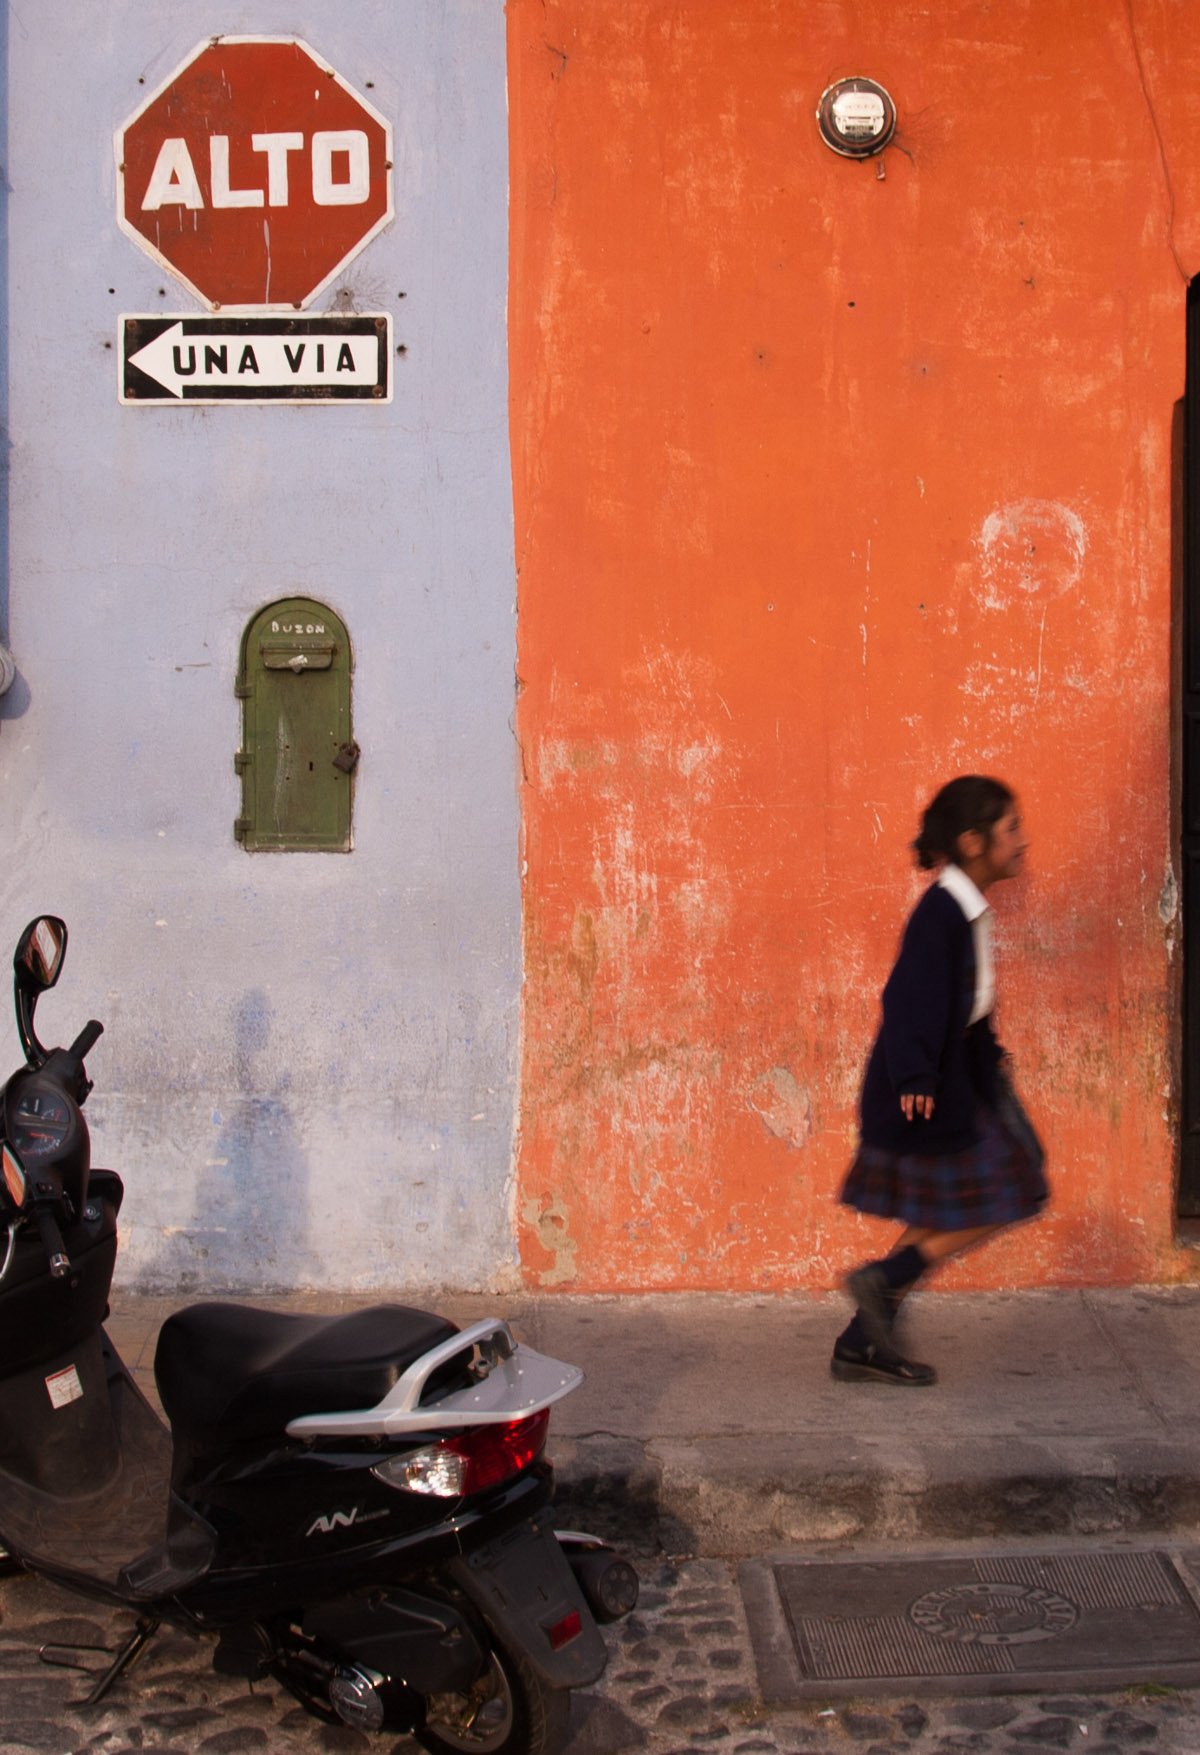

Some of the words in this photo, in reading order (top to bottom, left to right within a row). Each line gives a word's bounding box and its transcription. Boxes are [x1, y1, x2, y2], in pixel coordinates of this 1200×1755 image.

[141, 129, 370, 210] ALTO
[172, 344, 260, 376] UNA
[283, 343, 356, 374] VIA
[271, 621, 325, 633] BUZON
